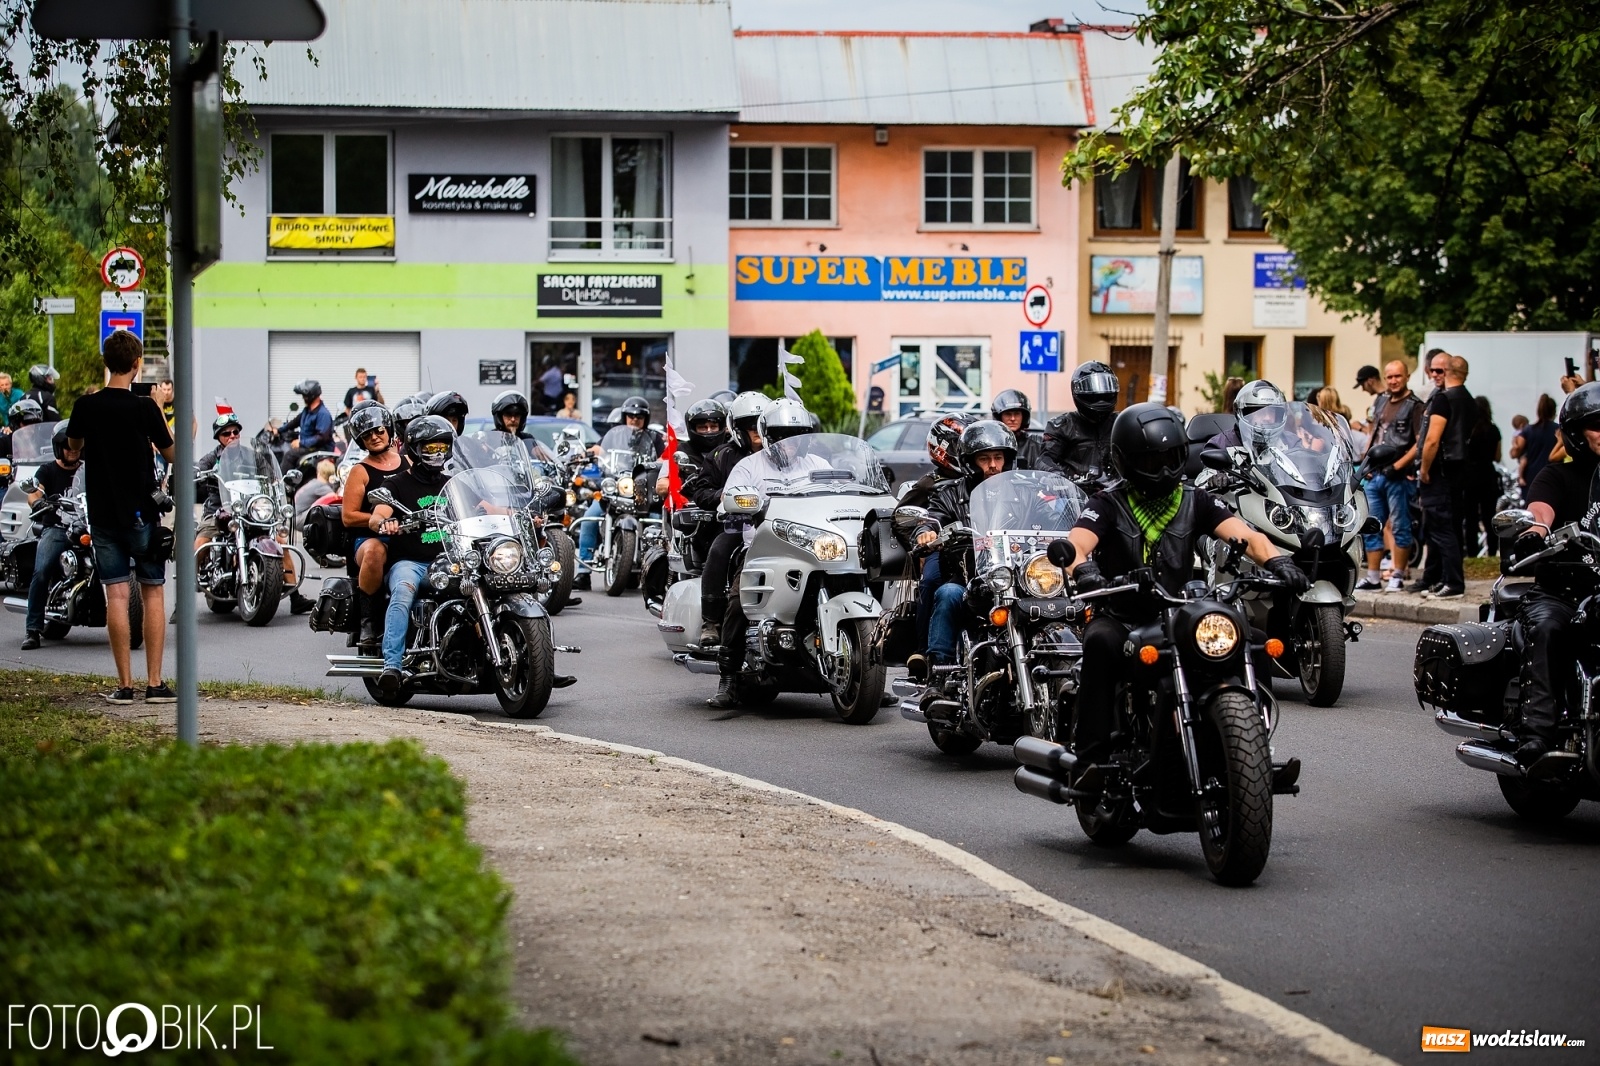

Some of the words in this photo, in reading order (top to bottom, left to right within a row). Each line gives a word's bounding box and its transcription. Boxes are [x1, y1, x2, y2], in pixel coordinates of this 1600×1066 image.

[414, 176, 531, 200] Mariebelle
[422, 200, 473, 211] kosmetyka
[474, 201, 481, 210] &
[483, 200, 508, 210] make
[509, 202, 523, 211] up
[276, 223, 310, 232] BIURO
[315, 236, 355, 244] SIMPLY
[737, 256, 871, 286] SUPER
[543, 275, 586, 288] SALON
[587, 275, 657, 288] FRYZJERSKI
[882, 288, 1025, 302] www.supermeble.eu
